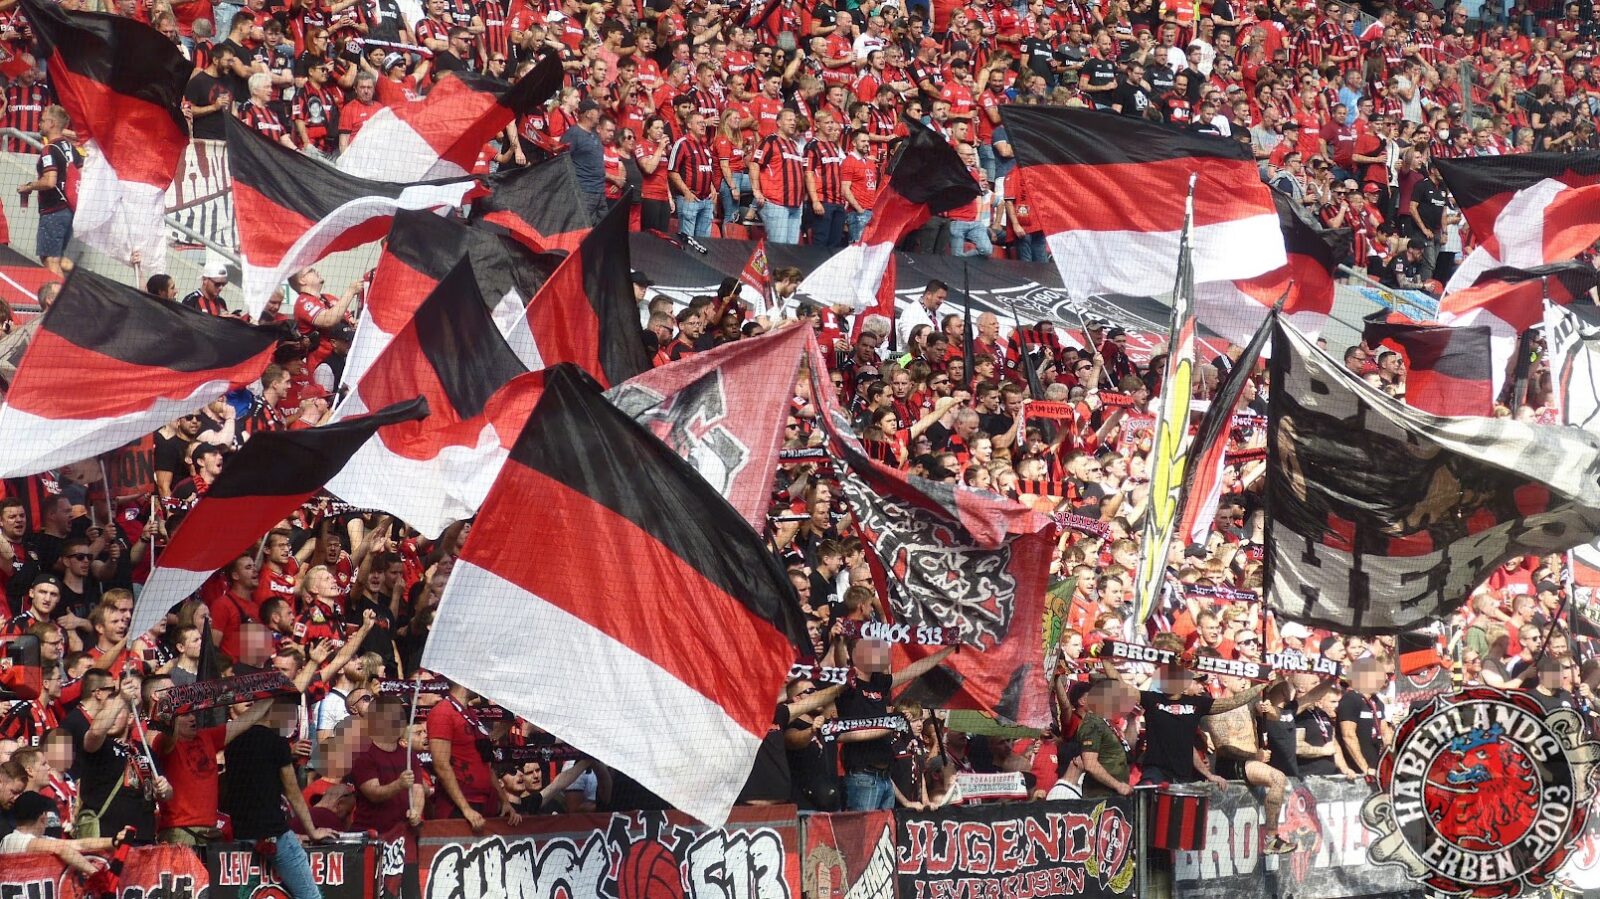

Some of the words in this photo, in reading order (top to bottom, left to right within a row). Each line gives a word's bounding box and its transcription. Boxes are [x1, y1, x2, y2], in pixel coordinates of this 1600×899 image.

[860, 621, 911, 644] CHAOS
[916, 625, 943, 646] 513
[1112, 641, 1175, 665] BROT
[1197, 656, 1260, 679] HERS
[1312, 656, 1338, 676] LEV
[819, 666, 848, 685] 513
[898, 811, 1096, 875] JUGEND
